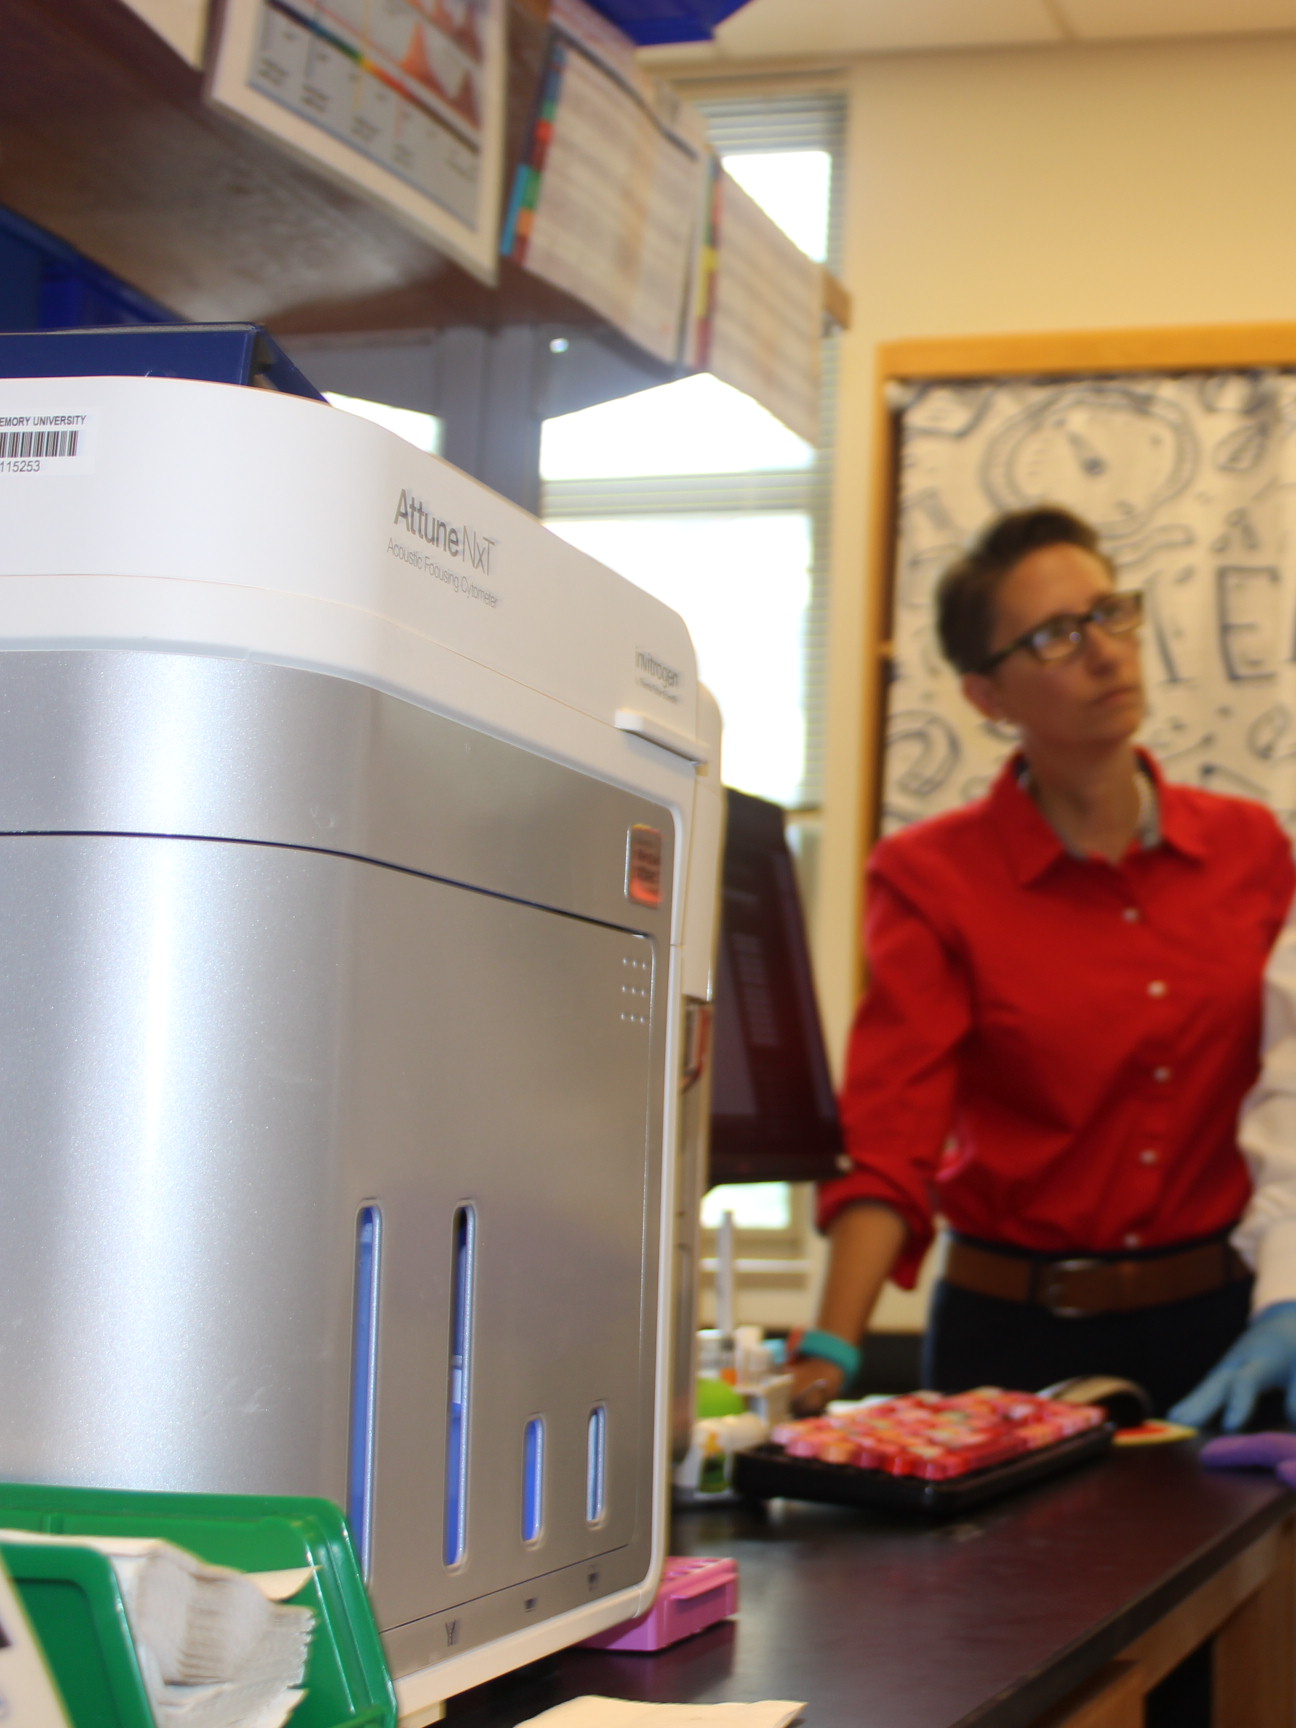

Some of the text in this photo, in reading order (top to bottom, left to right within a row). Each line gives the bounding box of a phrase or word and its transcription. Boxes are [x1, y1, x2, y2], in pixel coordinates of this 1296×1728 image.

[0, 414, 87, 427] EMORY UNIVERSITY
[394, 488, 496, 577] Attune NxT
[386, 536, 499, 609] Acoustic Focusing Cytometer
